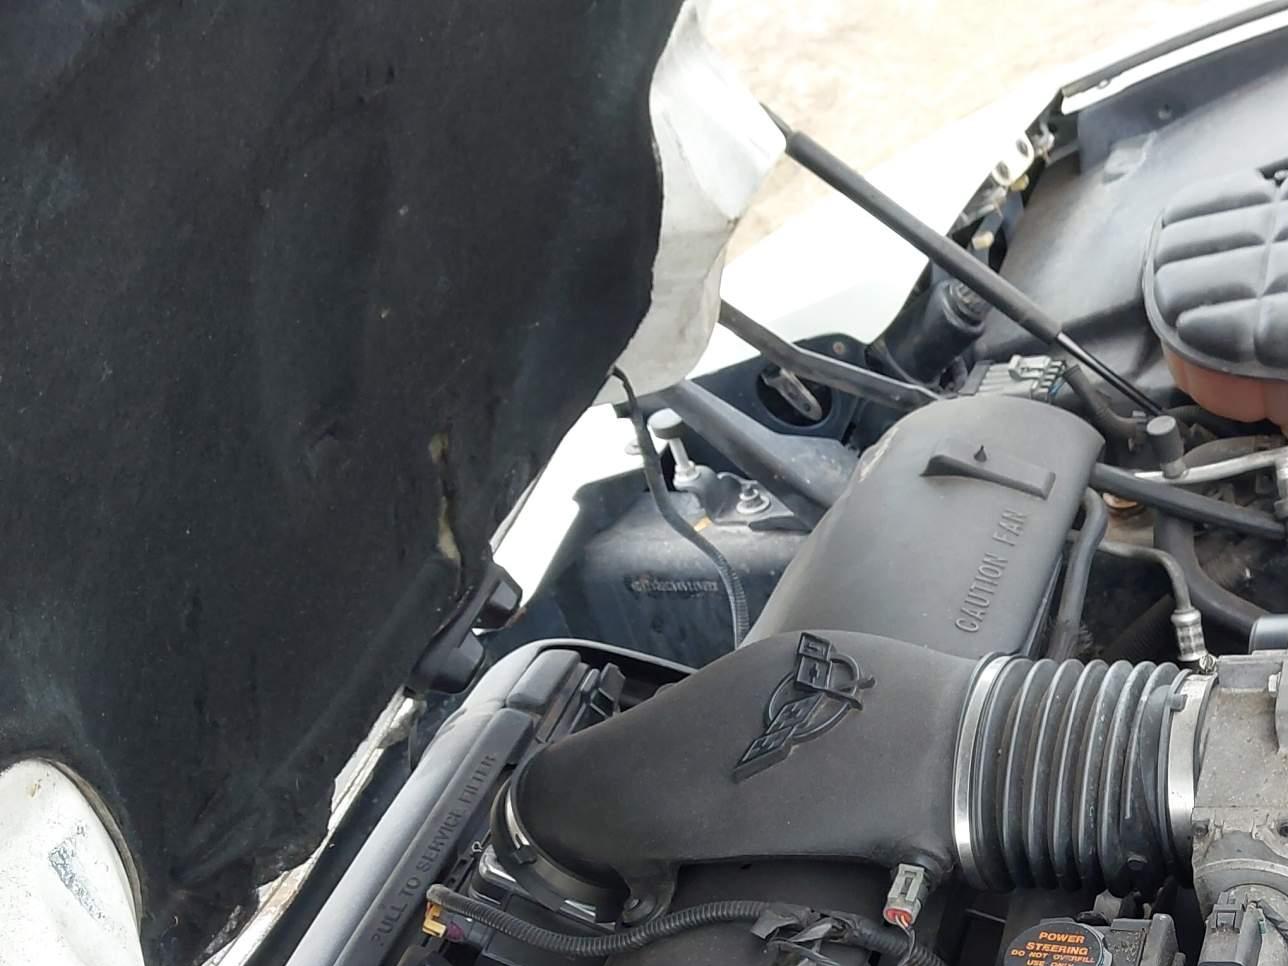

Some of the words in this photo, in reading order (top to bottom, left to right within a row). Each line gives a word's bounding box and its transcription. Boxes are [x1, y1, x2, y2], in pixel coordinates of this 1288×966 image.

[954, 552, 1009, 633] CAUTION
[992, 507, 1027, 547] FAN
[370, 902, 408, 947] PULL
[401, 876, 421, 898] TO
[416, 808, 462, 873] SERVICE
[459, 755, 497, 804] FILTER
[1039, 931, 1086, 944] POWER
[1025, 941, 1089, 956] STEERING
[1010, 949, 1026, 957] DO
[1028, 951, 1049, 959] NOT
[1052, 954, 1096, 964] OVERFILL
[1026, 959, 1046, 966] USE
